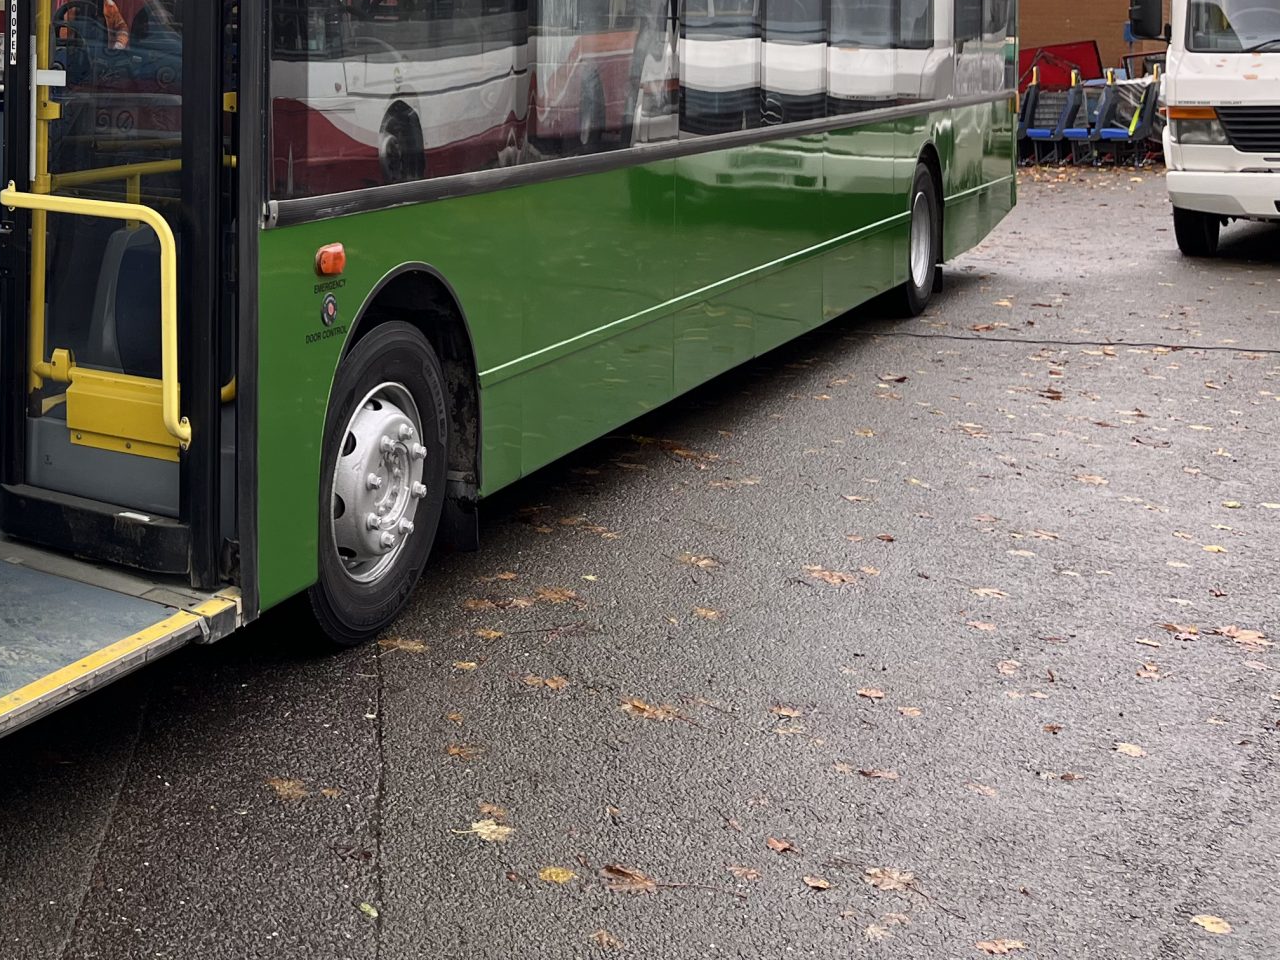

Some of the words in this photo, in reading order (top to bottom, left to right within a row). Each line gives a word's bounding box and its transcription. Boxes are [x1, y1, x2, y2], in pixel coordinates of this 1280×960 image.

[313, 279, 346, 294] EMERGENCY
[305, 331, 322, 344] DOOR
[322, 325, 347, 341] CONTROL
